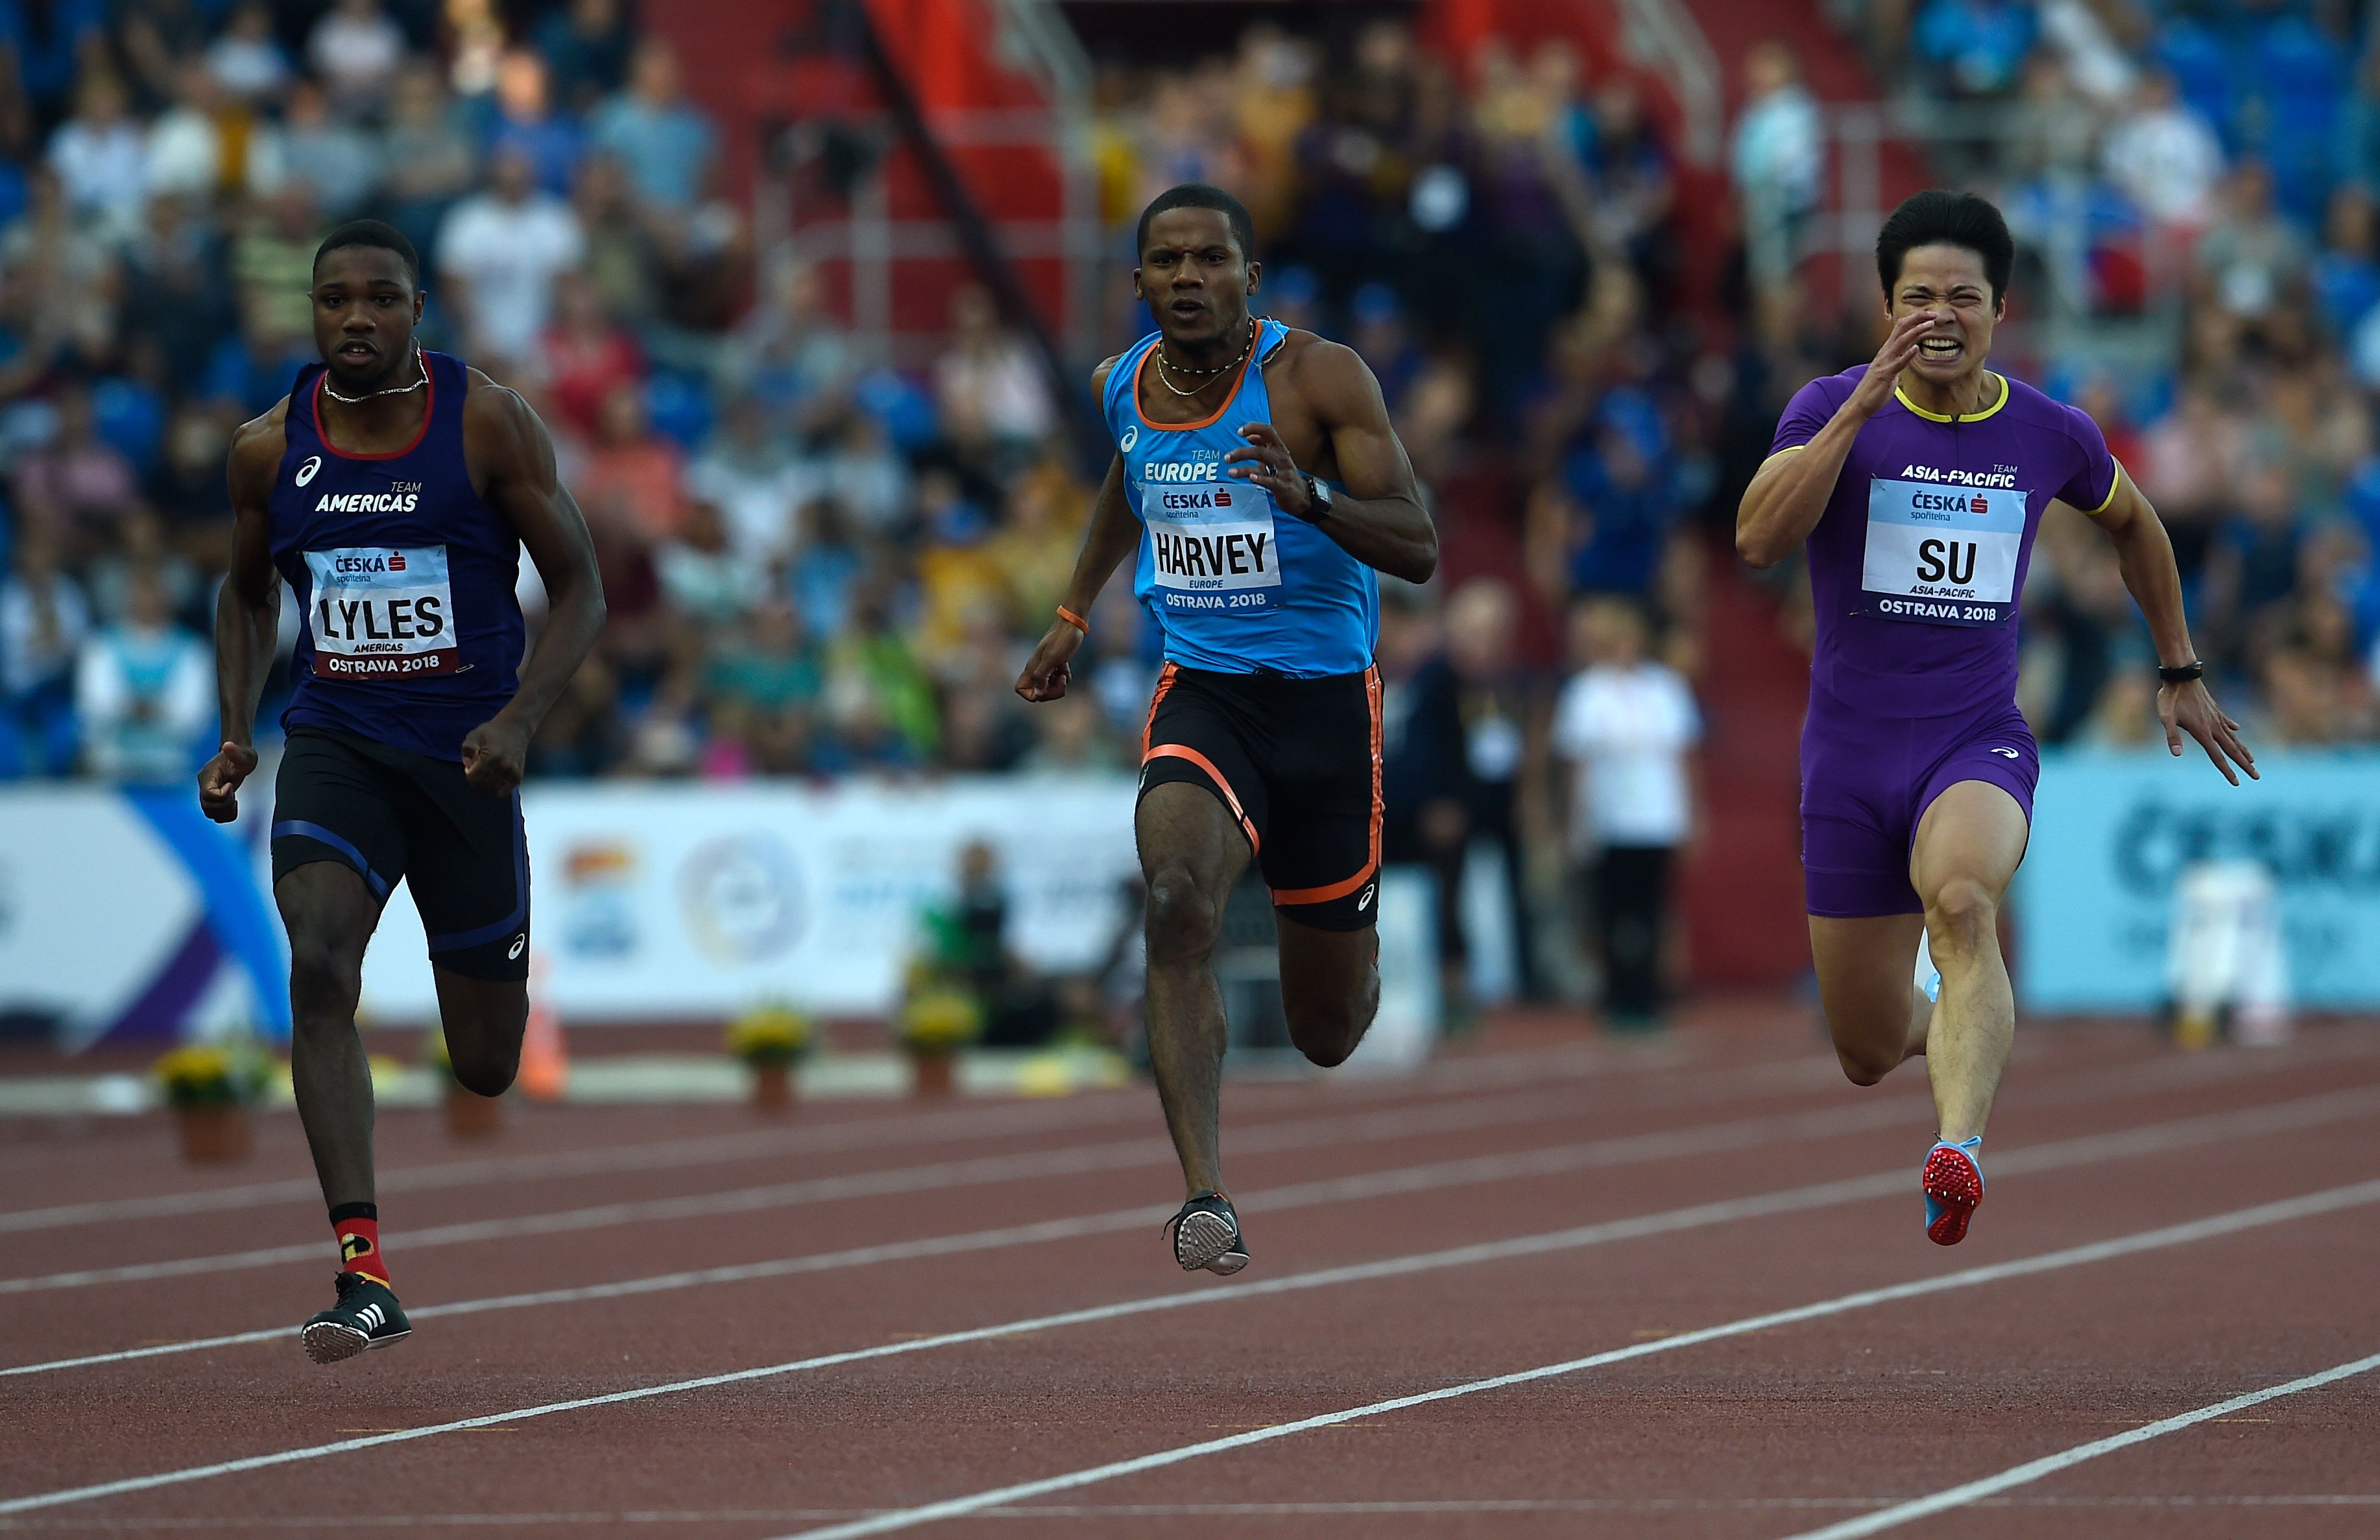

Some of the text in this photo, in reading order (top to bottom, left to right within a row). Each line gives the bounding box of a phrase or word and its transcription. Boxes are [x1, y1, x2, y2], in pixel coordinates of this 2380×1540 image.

[1192, 450, 1220, 461] TEAM
[1145, 462, 1219, 481] EUROPE
[1993, 464, 2018, 474] TEAM
[391, 482, 422, 492] TEAM
[315, 494, 418, 512] AMERICAS
[1162, 491, 1212, 509] ČESKÁ
[1912, 490, 1967, 512] ČESKÁ
[335, 553, 386, 573] ČESKÁ
[1156, 533, 1267, 577] HARVEY
[1916, 538, 1977, 584] SU
[1189, 580, 1224, 588] EUROPE
[1909, 585, 1976, 598] ASIA-PACIFIC
[1166, 594, 1266, 608] OSTRAVA 2018
[1879, 599, 1997, 621] OSTRAVA 2018
[319, 596, 443, 640] LYLES
[353, 643, 403, 653] AMERICAS
[329, 655, 440, 673] OSTRAVA 2018
